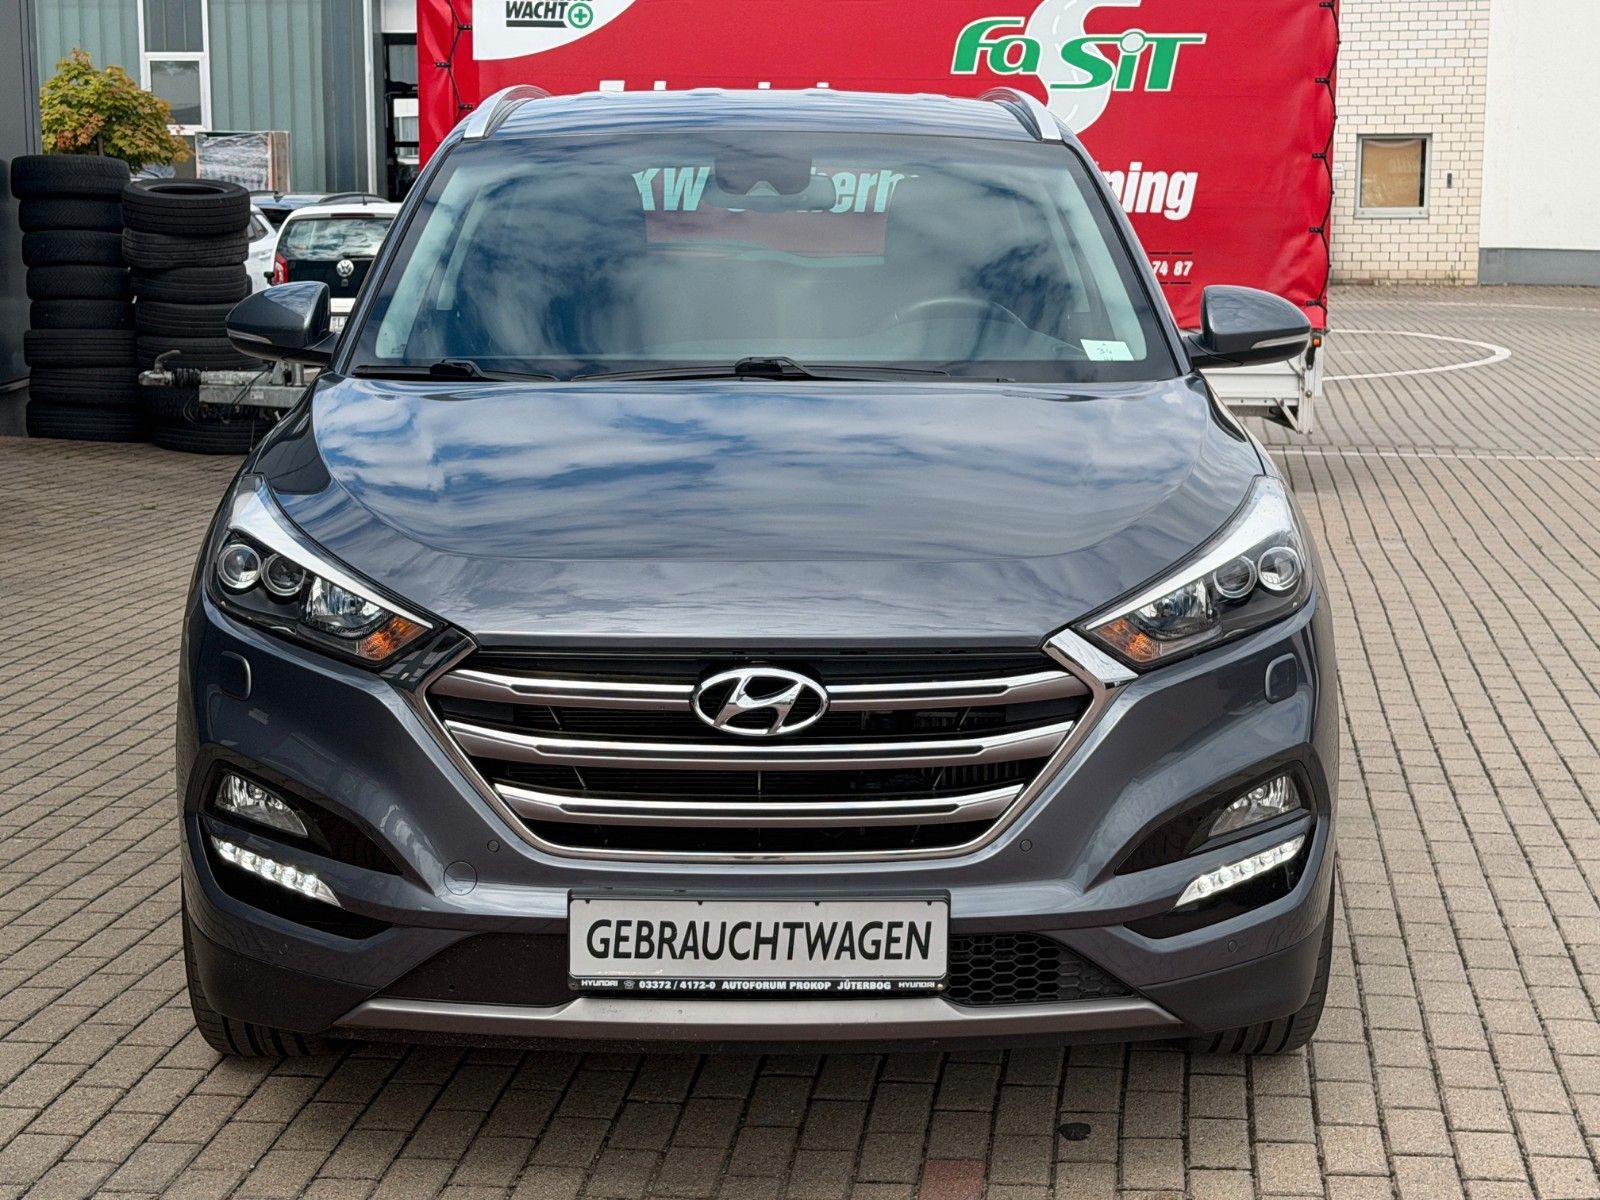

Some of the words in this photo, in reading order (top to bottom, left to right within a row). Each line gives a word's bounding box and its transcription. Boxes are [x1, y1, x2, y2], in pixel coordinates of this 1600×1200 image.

[506, 1, 568, 19] WACHT
[1152, 260, 1168, 276] 74
[1173, 260, 1193, 276] 87
[586, 918, 932, 961] GEBRAUCHTWAGEN
[581, 979, 618, 987] HYUNDAI
[638, 981, 672, 990] 03372
[679, 981, 716, 990] 4172-0
[722, 981, 787, 990] AUTOFORUM
[789, 981, 832, 990] PROKOP
[837, 979, 892, 990] JÜTERBOG
